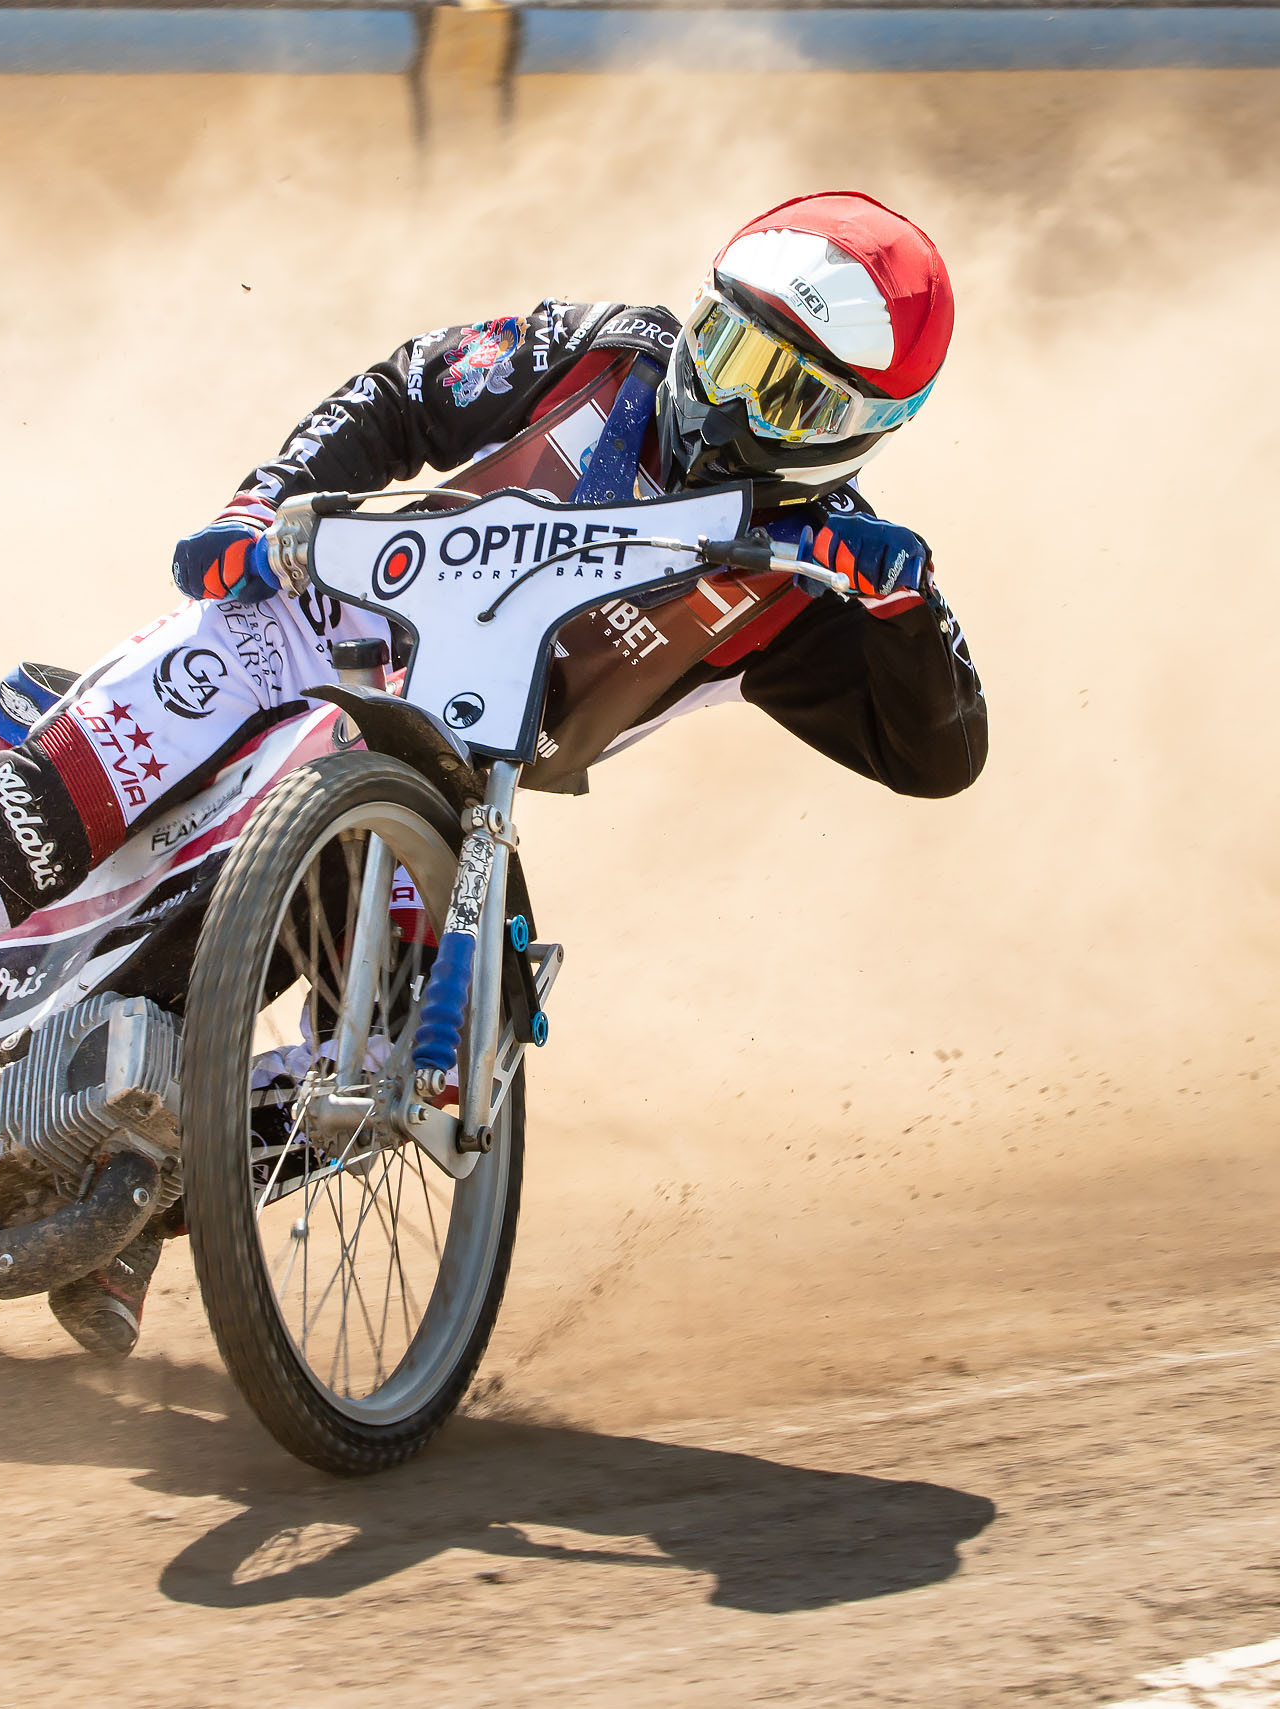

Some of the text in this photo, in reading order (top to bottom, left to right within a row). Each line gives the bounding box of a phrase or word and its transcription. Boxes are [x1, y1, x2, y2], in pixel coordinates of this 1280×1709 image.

[439, 522, 637, 566] OPTIBET
[438, 566, 623, 581] SPORT BĀRS
[603, 628, 639, 666] BĀRS
[75, 701, 148, 808] LATVIA
